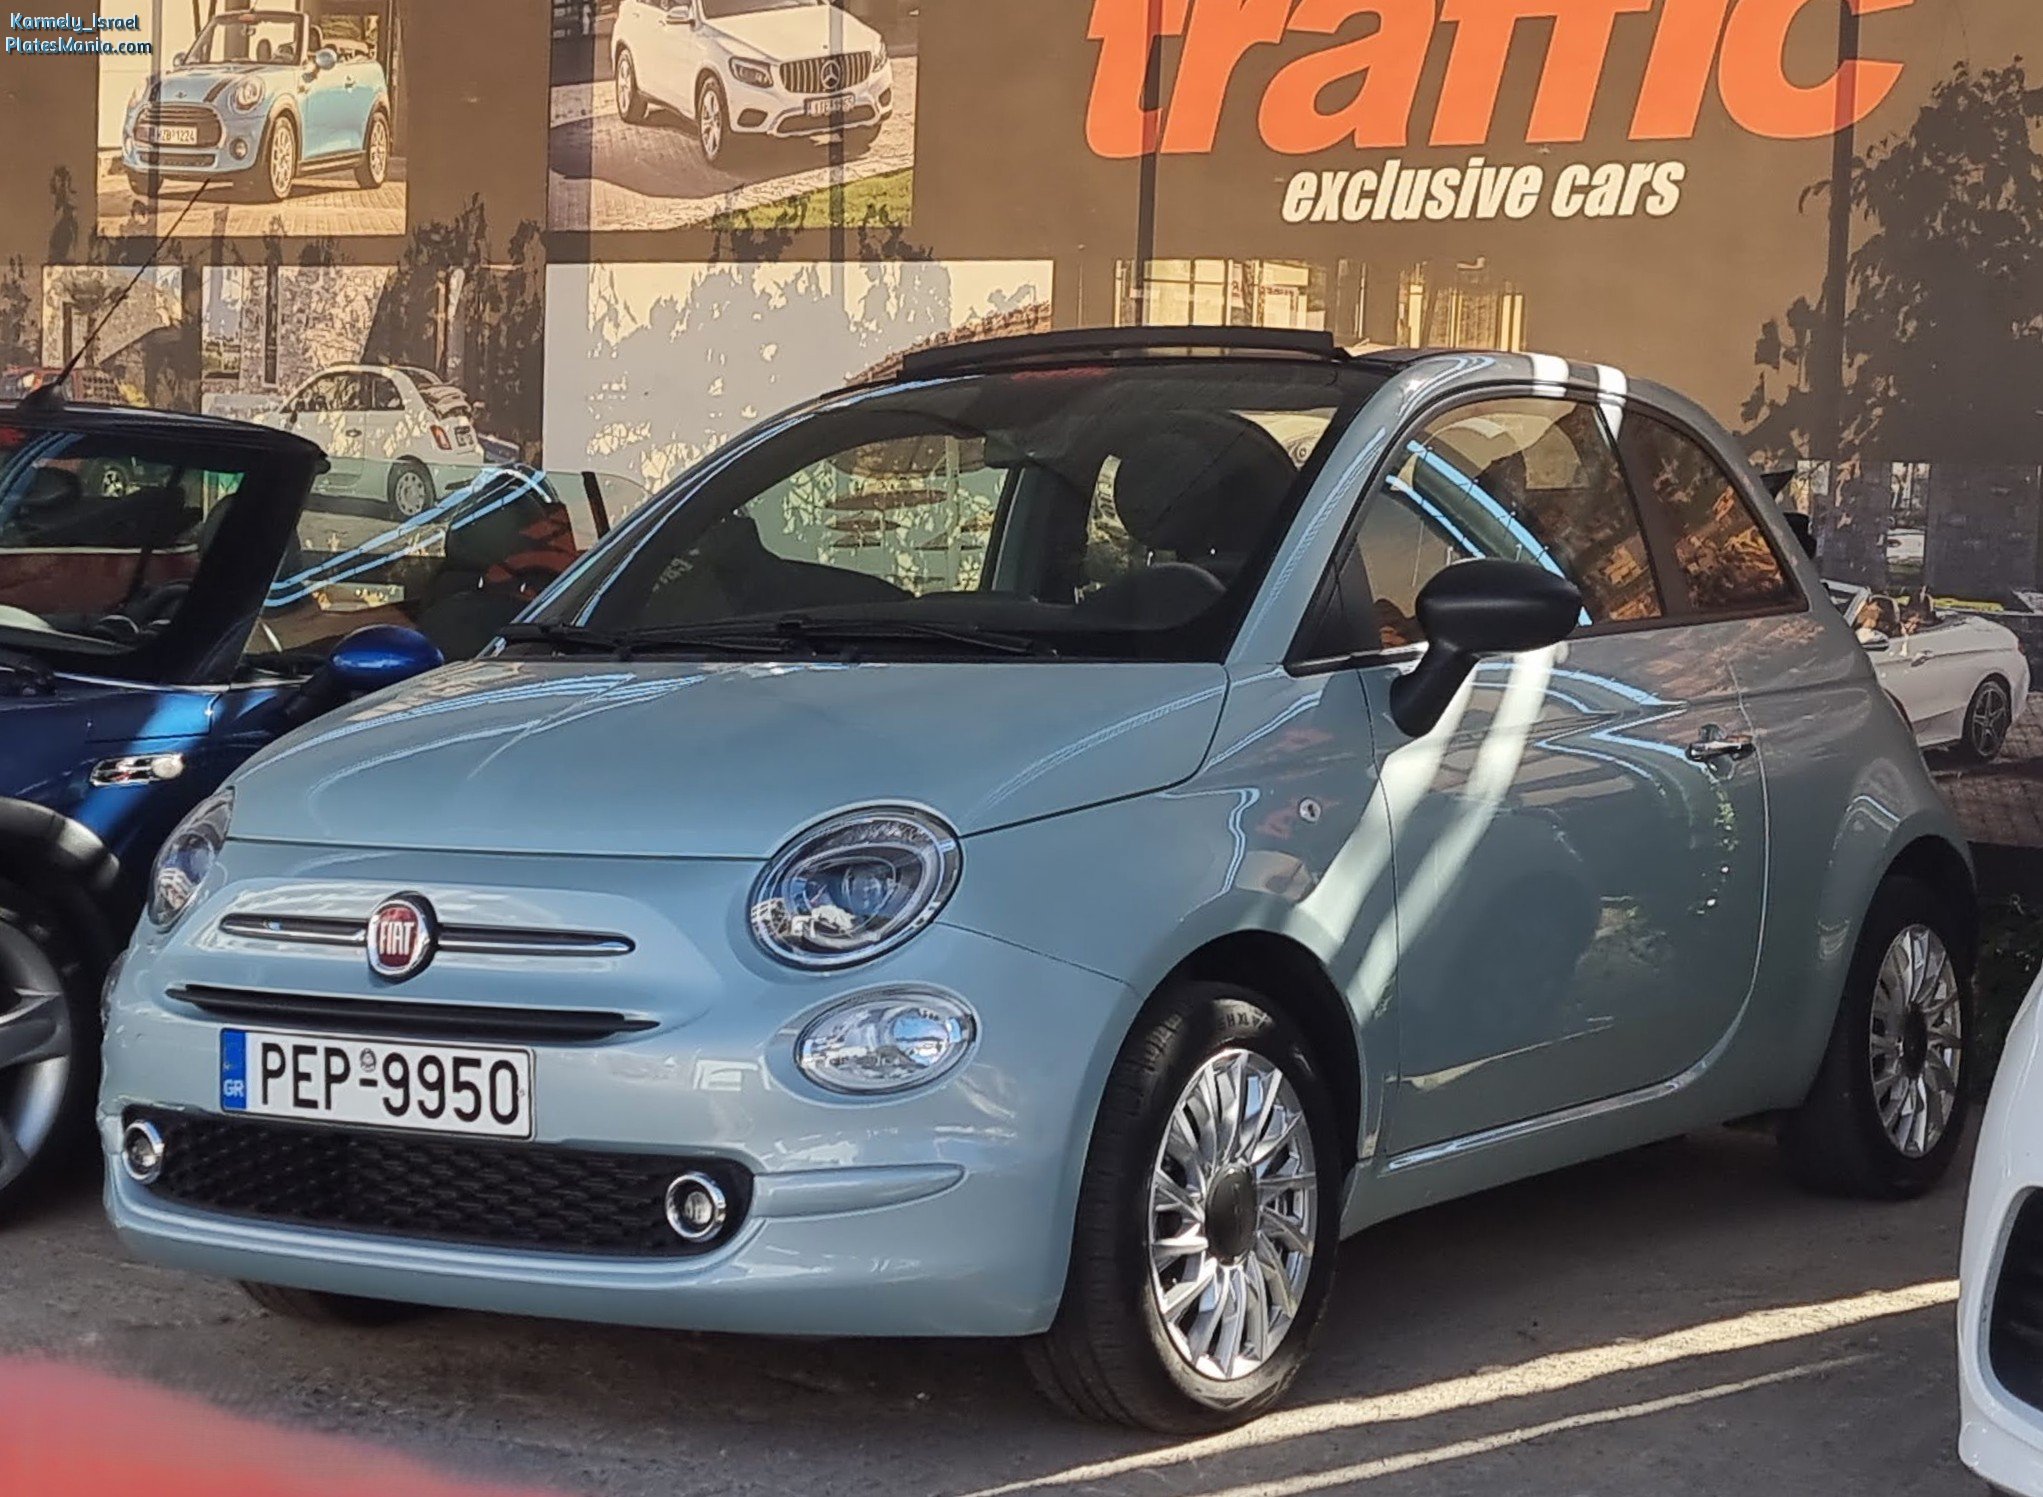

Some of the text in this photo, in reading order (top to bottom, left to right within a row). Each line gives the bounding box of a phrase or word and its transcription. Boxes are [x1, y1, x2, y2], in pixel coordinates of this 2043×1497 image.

[1282, 157, 1685, 222] exclusive cars
[379, 921, 415, 955] FIAT
[223, 1079, 245, 1098] GR
[261, 1042, 519, 1125] PEP-9950
